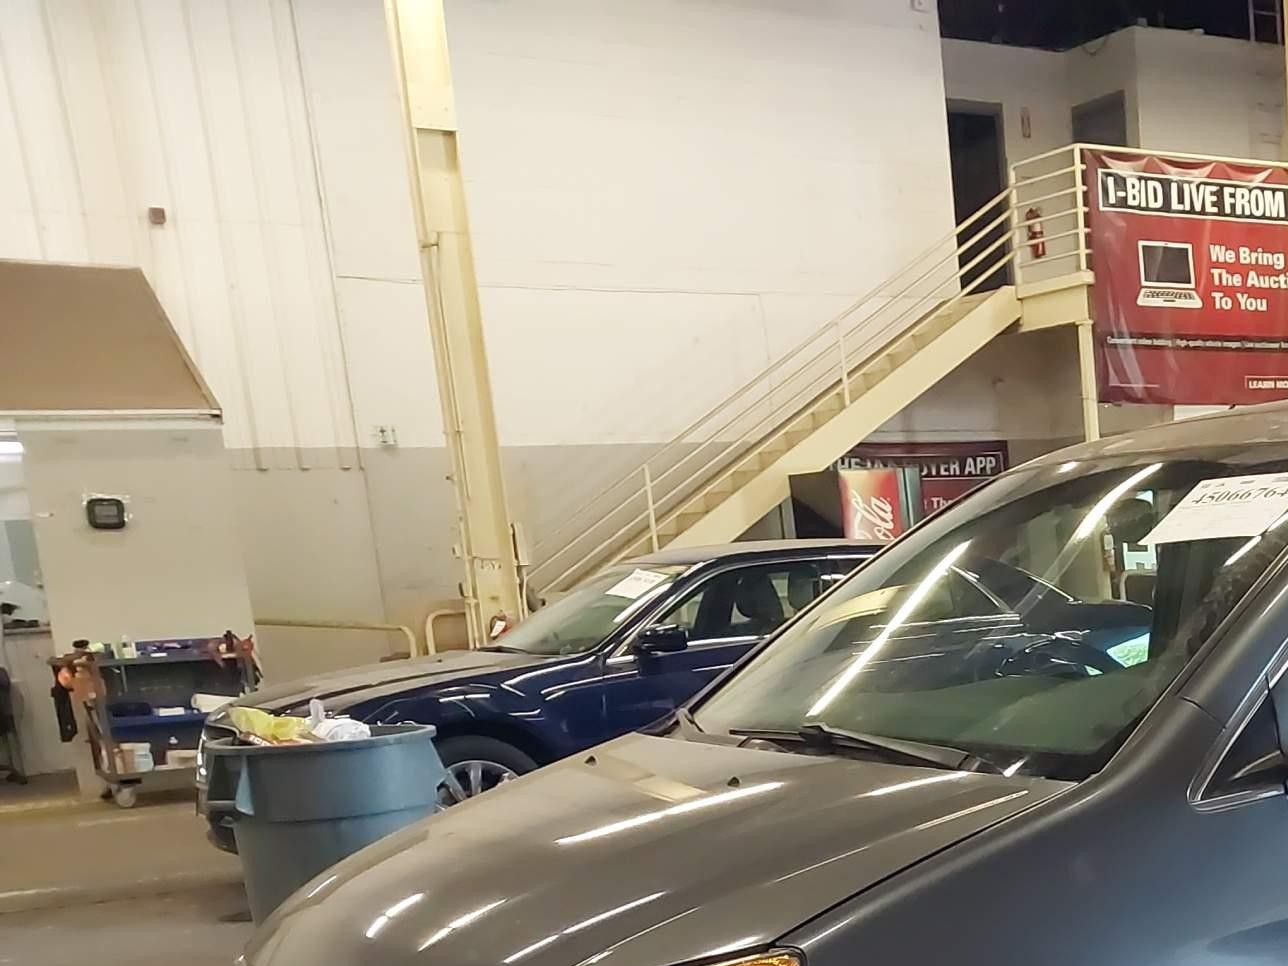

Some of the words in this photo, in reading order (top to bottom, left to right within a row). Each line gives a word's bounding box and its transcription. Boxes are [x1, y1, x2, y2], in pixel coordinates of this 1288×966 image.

[1107, 175, 1164, 209] I-BID
[1170, 181, 1219, 214] LIVE
[1223, 186, 1286, 218] FROM
[1209, 244, 1236, 264] We
[1239, 246, 1285, 270] Bring
[1210, 268, 1243, 287] The
[1211, 291, 1233, 310] To
[1235, 292, 1268, 311] You
[921, 458, 960, 476] YER
[964, 456, 996, 475] APP
